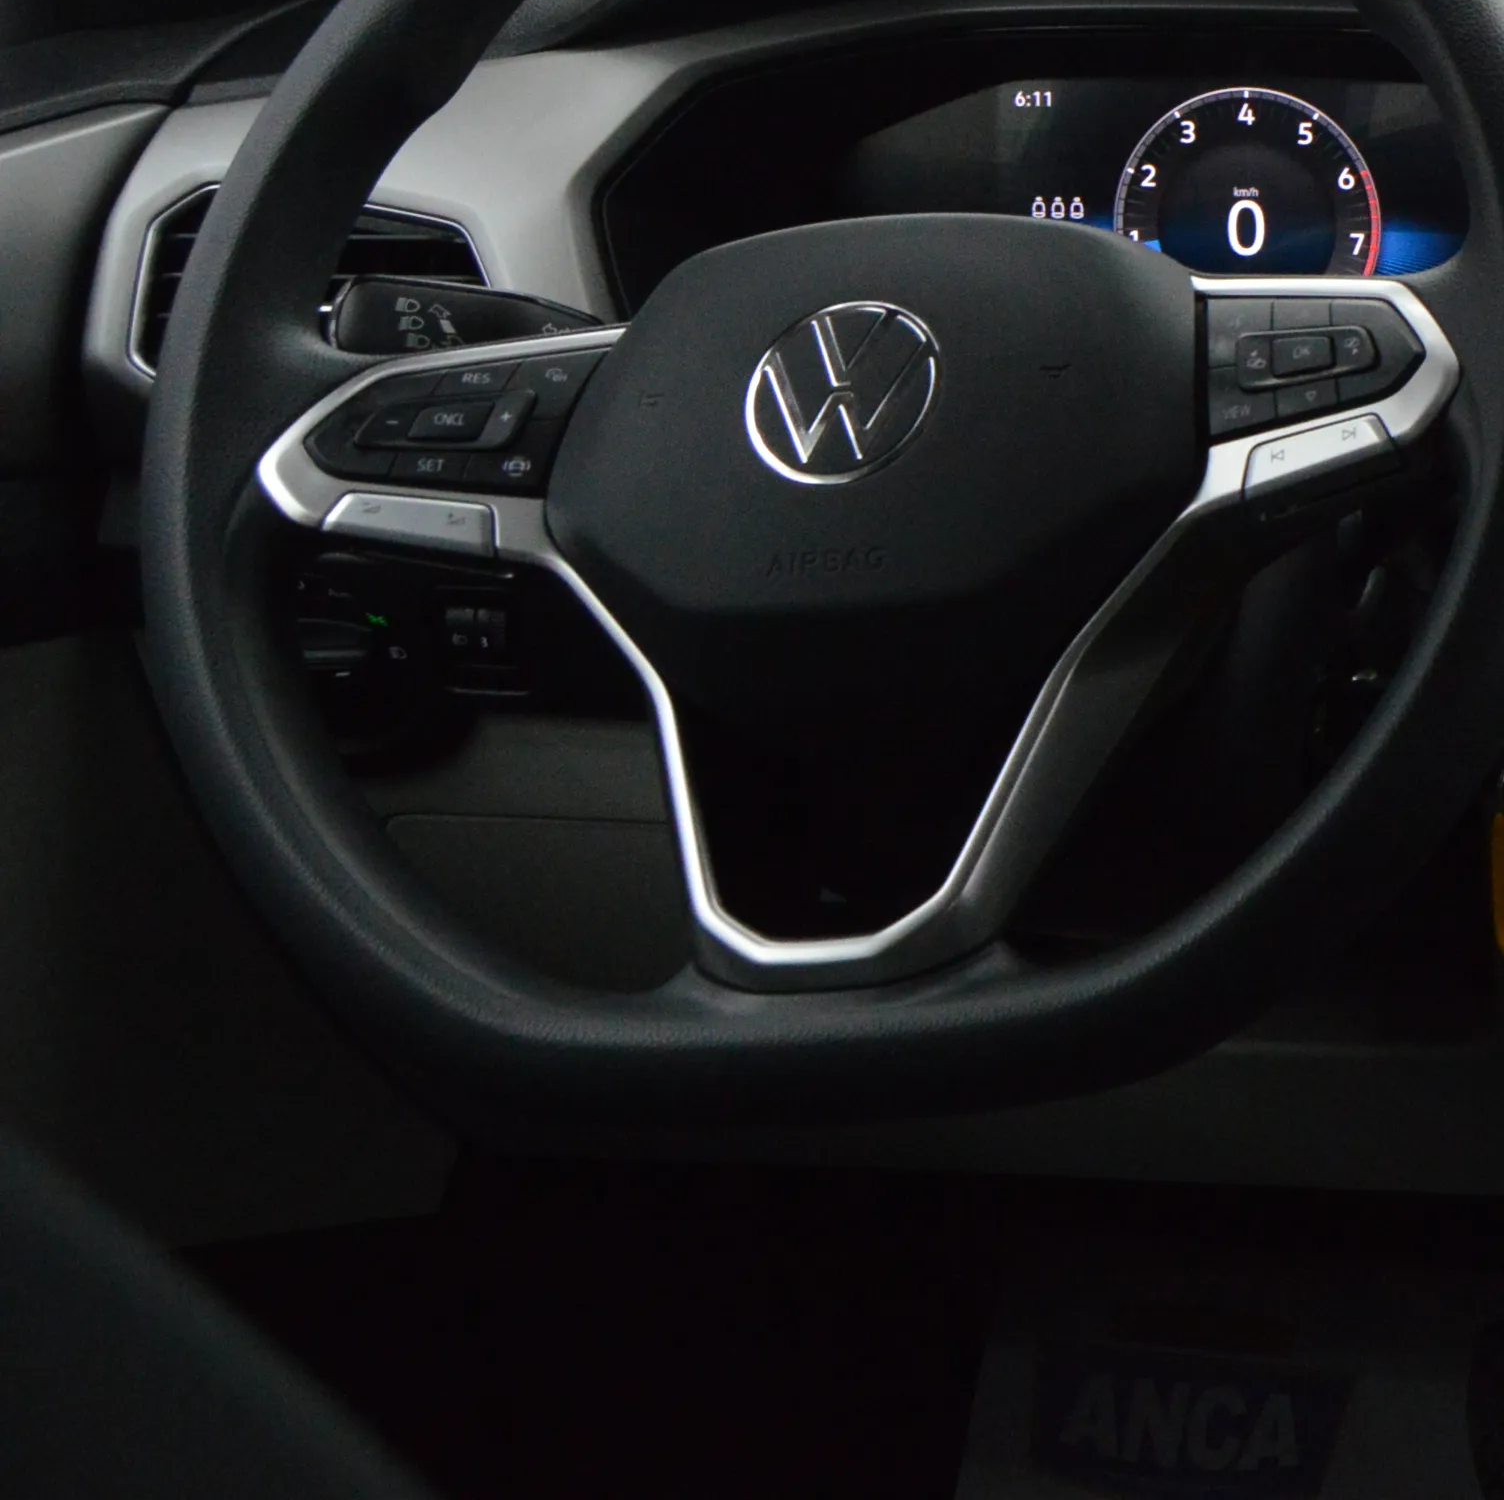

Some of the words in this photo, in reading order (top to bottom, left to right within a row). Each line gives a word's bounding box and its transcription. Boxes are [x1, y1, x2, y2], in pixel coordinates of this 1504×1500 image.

[1013, 90, 1052, 108] 6:11
[1236, 102, 1256, 126] 4
[1179, 120, 1196, 145] 3
[1297, 121, 1314, 146] 5
[1140, 163, 1157, 188] 2
[1337, 167, 1356, 191] 6
[1232, 186, 1259, 198] km/h
[1226, 199, 1266, 258] 0
[1349, 232, 1366, 256] 7
[461, 372, 491, 384] RES
[433, 412, 464, 426] CNCL
[417, 458, 444, 472] SET
